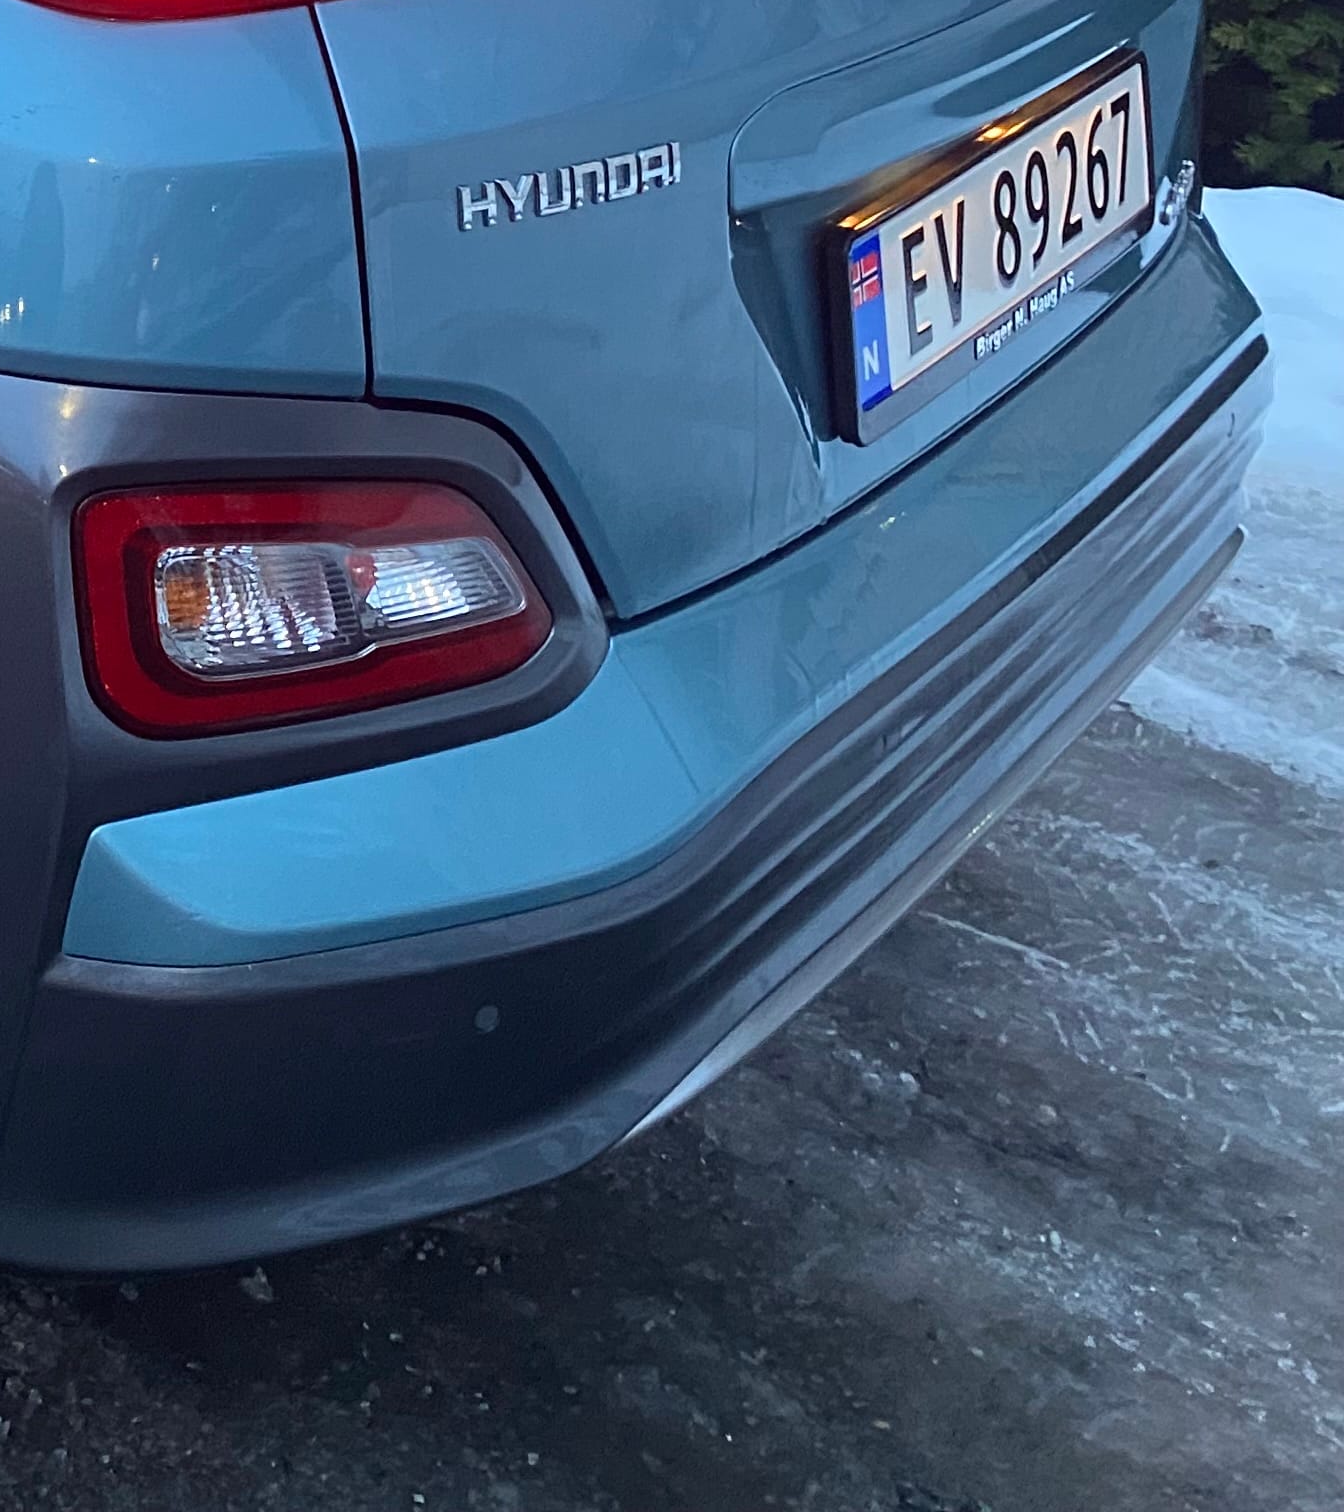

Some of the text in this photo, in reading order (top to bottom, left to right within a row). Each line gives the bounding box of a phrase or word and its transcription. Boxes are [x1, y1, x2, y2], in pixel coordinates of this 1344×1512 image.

[457, 141, 681, 231] HYUNDAI
[901, 91, 1131, 356] EV 89267
[974, 270, 1075, 360] Birger N. Haug AS
[862, 341, 880, 381] N
